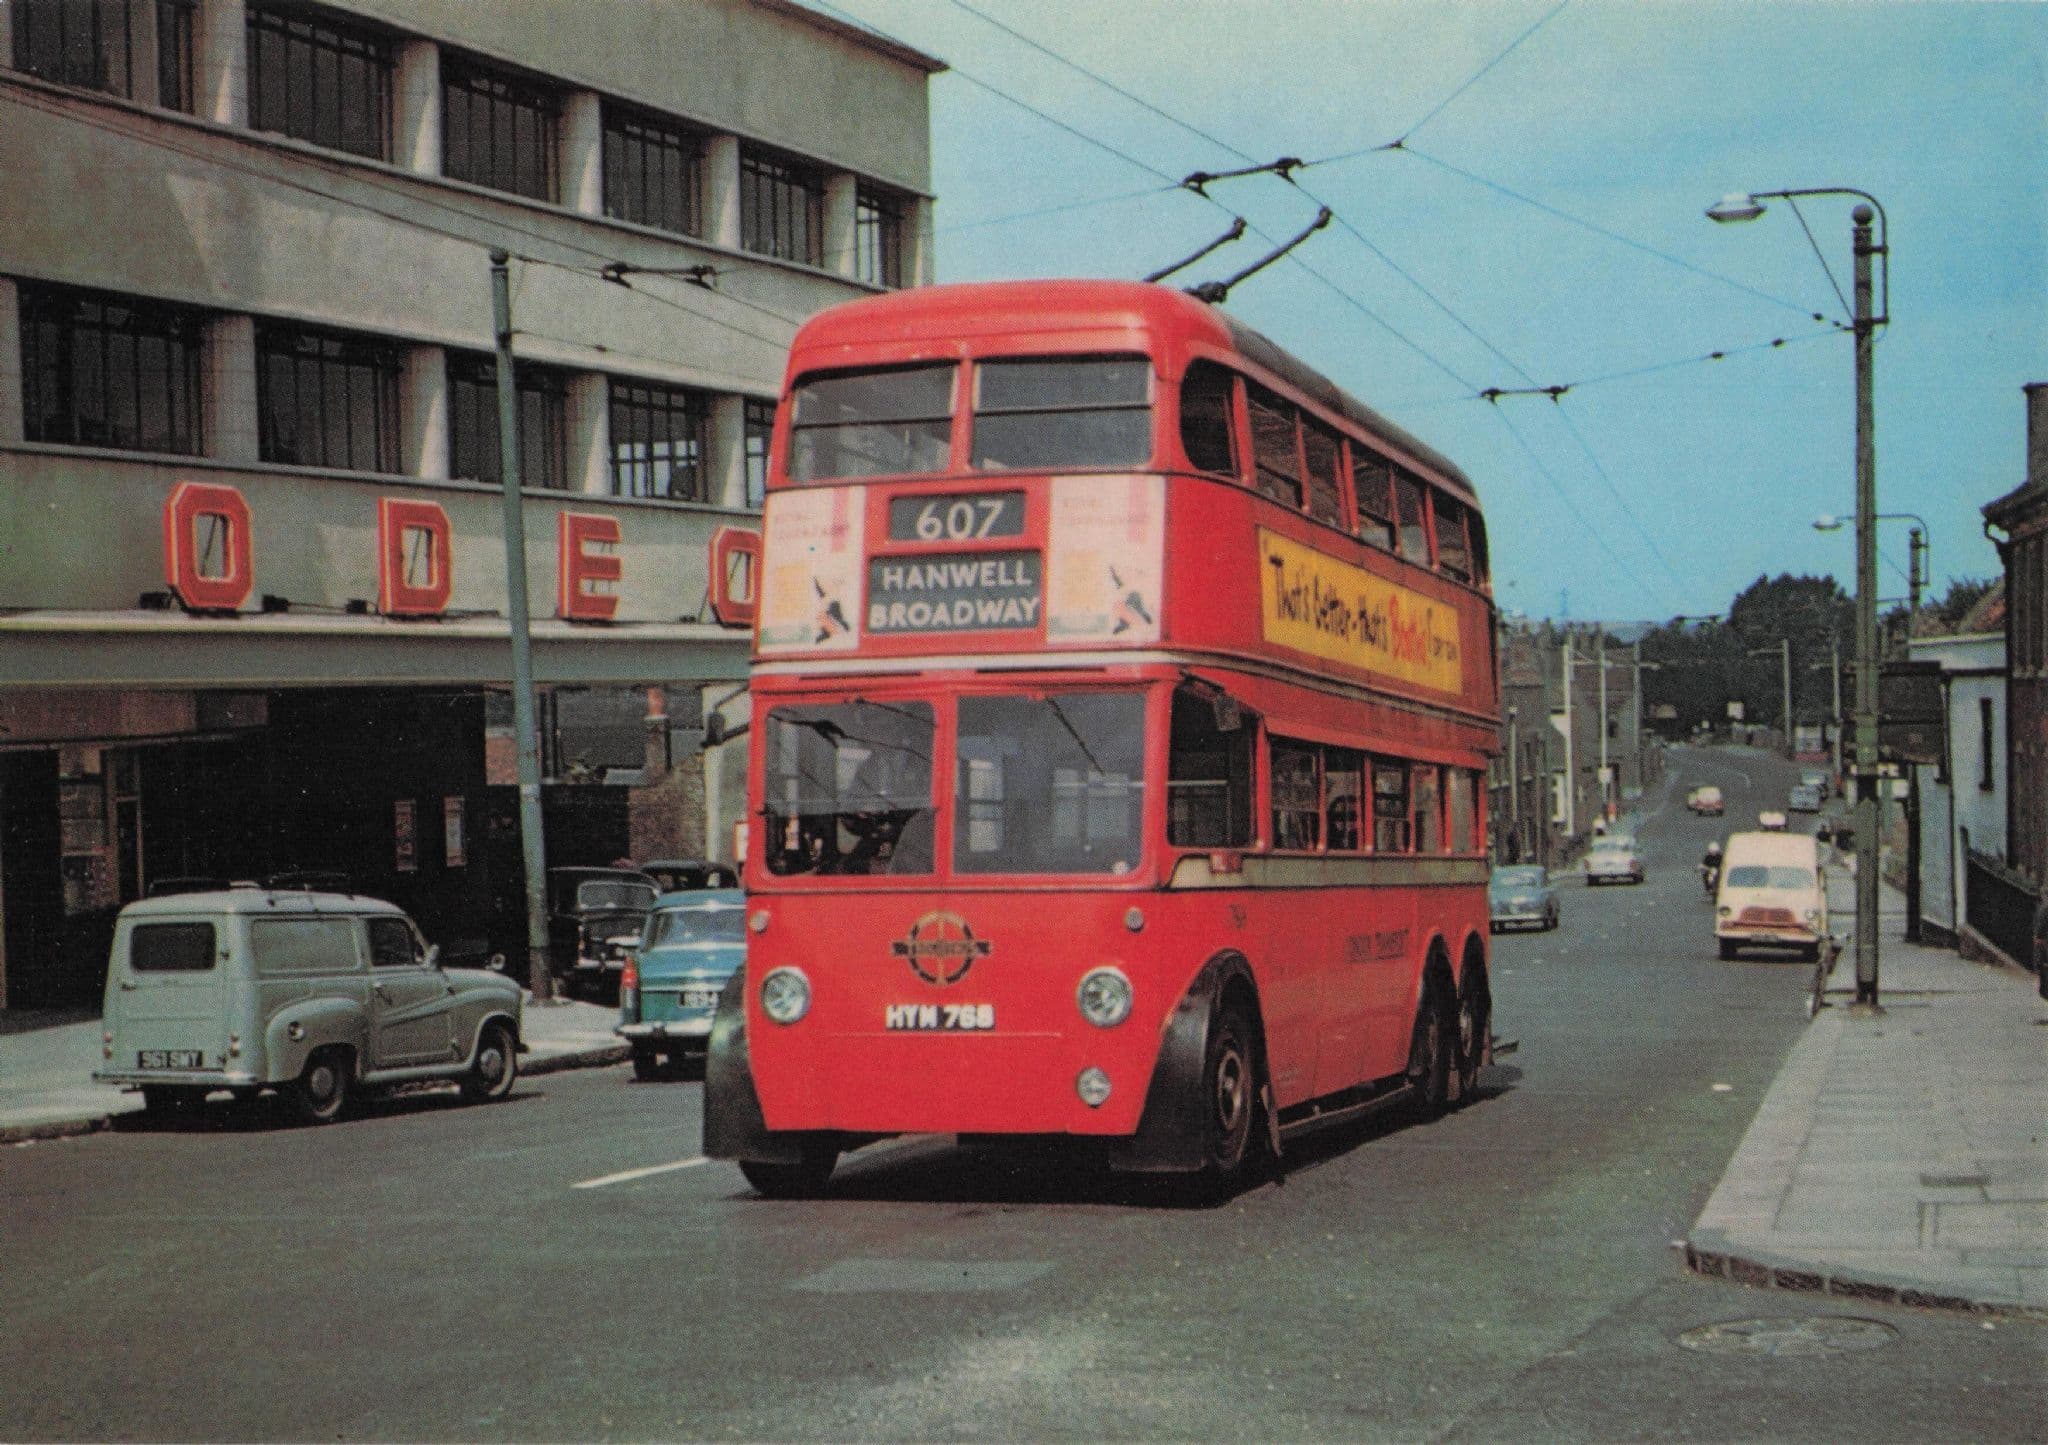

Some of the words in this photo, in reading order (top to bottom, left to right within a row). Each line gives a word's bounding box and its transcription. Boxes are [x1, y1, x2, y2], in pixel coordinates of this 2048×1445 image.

[916, 499, 1004, 539] 607
[882, 560, 1033, 591] HANWELL
[869, 596, 1041, 630] BROADWAY
[943, 1003, 995, 1030] 768
